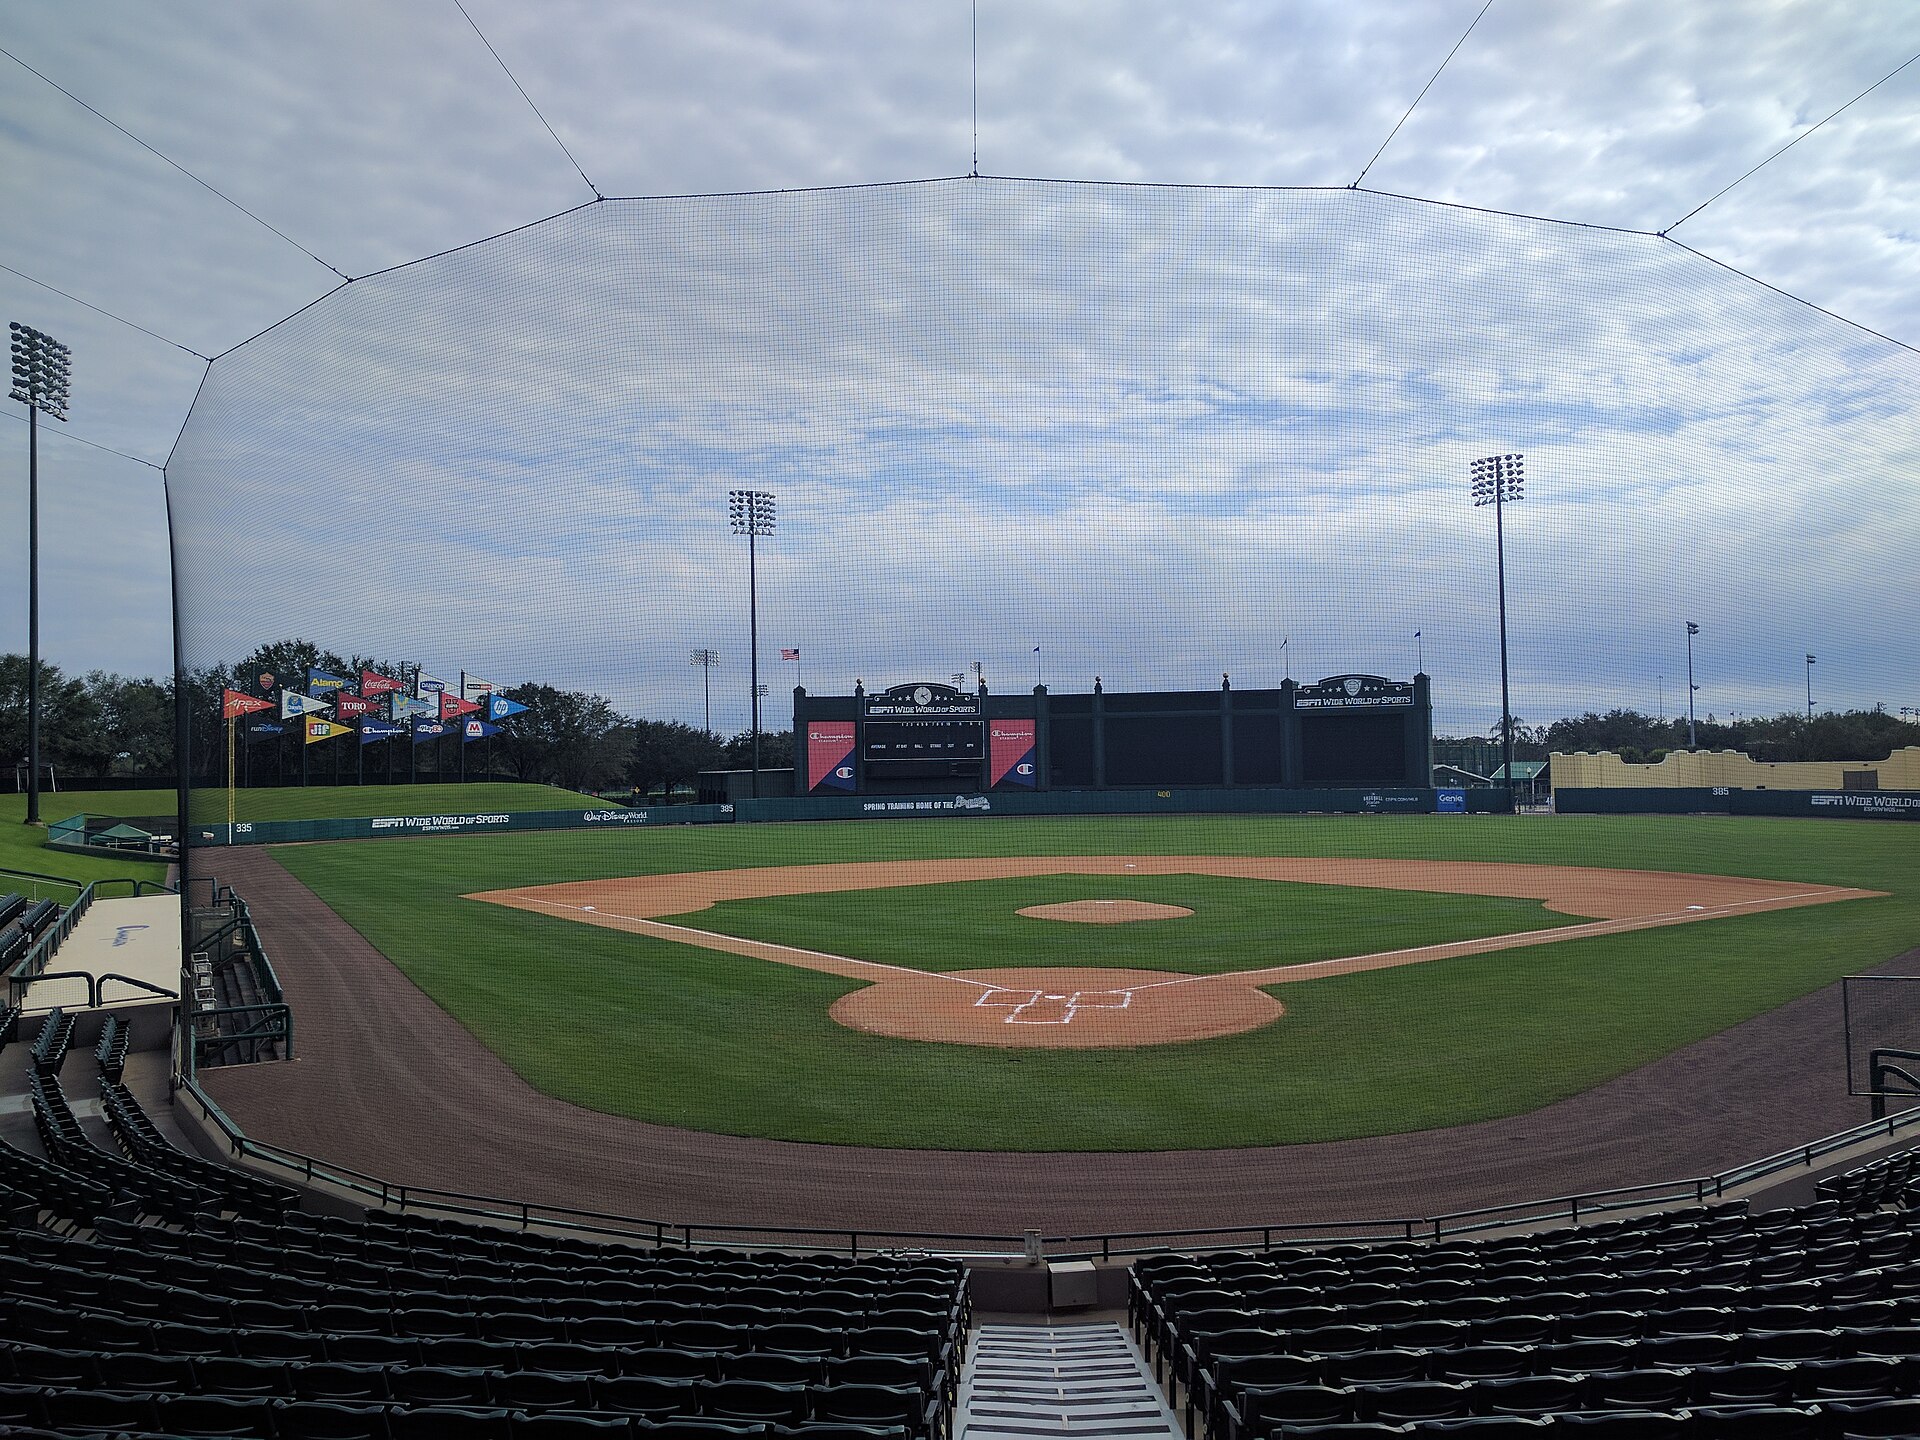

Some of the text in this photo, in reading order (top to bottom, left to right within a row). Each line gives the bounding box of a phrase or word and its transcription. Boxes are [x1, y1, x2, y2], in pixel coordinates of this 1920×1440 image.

[311, 678, 344, 688] Alamo
[341, 702, 367, 710] TORO
[1323, 698, 1344, 706] WIDE
[1344, 697, 1372, 705] WORLD
[1381, 696, 1411, 704] SPORTS
[496, 702, 507, 712] hp
[869, 706, 894, 714] ESPN
[894, 705, 915, 713] WIDE
[915, 705, 941, 713] WORLD
[949, 705, 976, 713] SPORTS
[362, 727, 404, 735] Champion
[1157, 790, 1170, 798] 400
[1712, 787, 1729, 796] 385
[863, 802, 886, 811] SPRING
[887, 802, 915, 810] TRAINING
[915, 802, 933, 810] HOME
[933, 801, 941, 809] OF
[942, 801, 954, 809] THE
[1811, 795, 1844, 805] ESPN
[1844, 795, 1873, 806] WIDE
[1872, 796, 1912, 807] WORLD
[628, 811, 647, 819] World
[371, 814, 509, 829] ESPN WIDE WORLD OF SPORTS
[236, 823, 252, 833] 335
